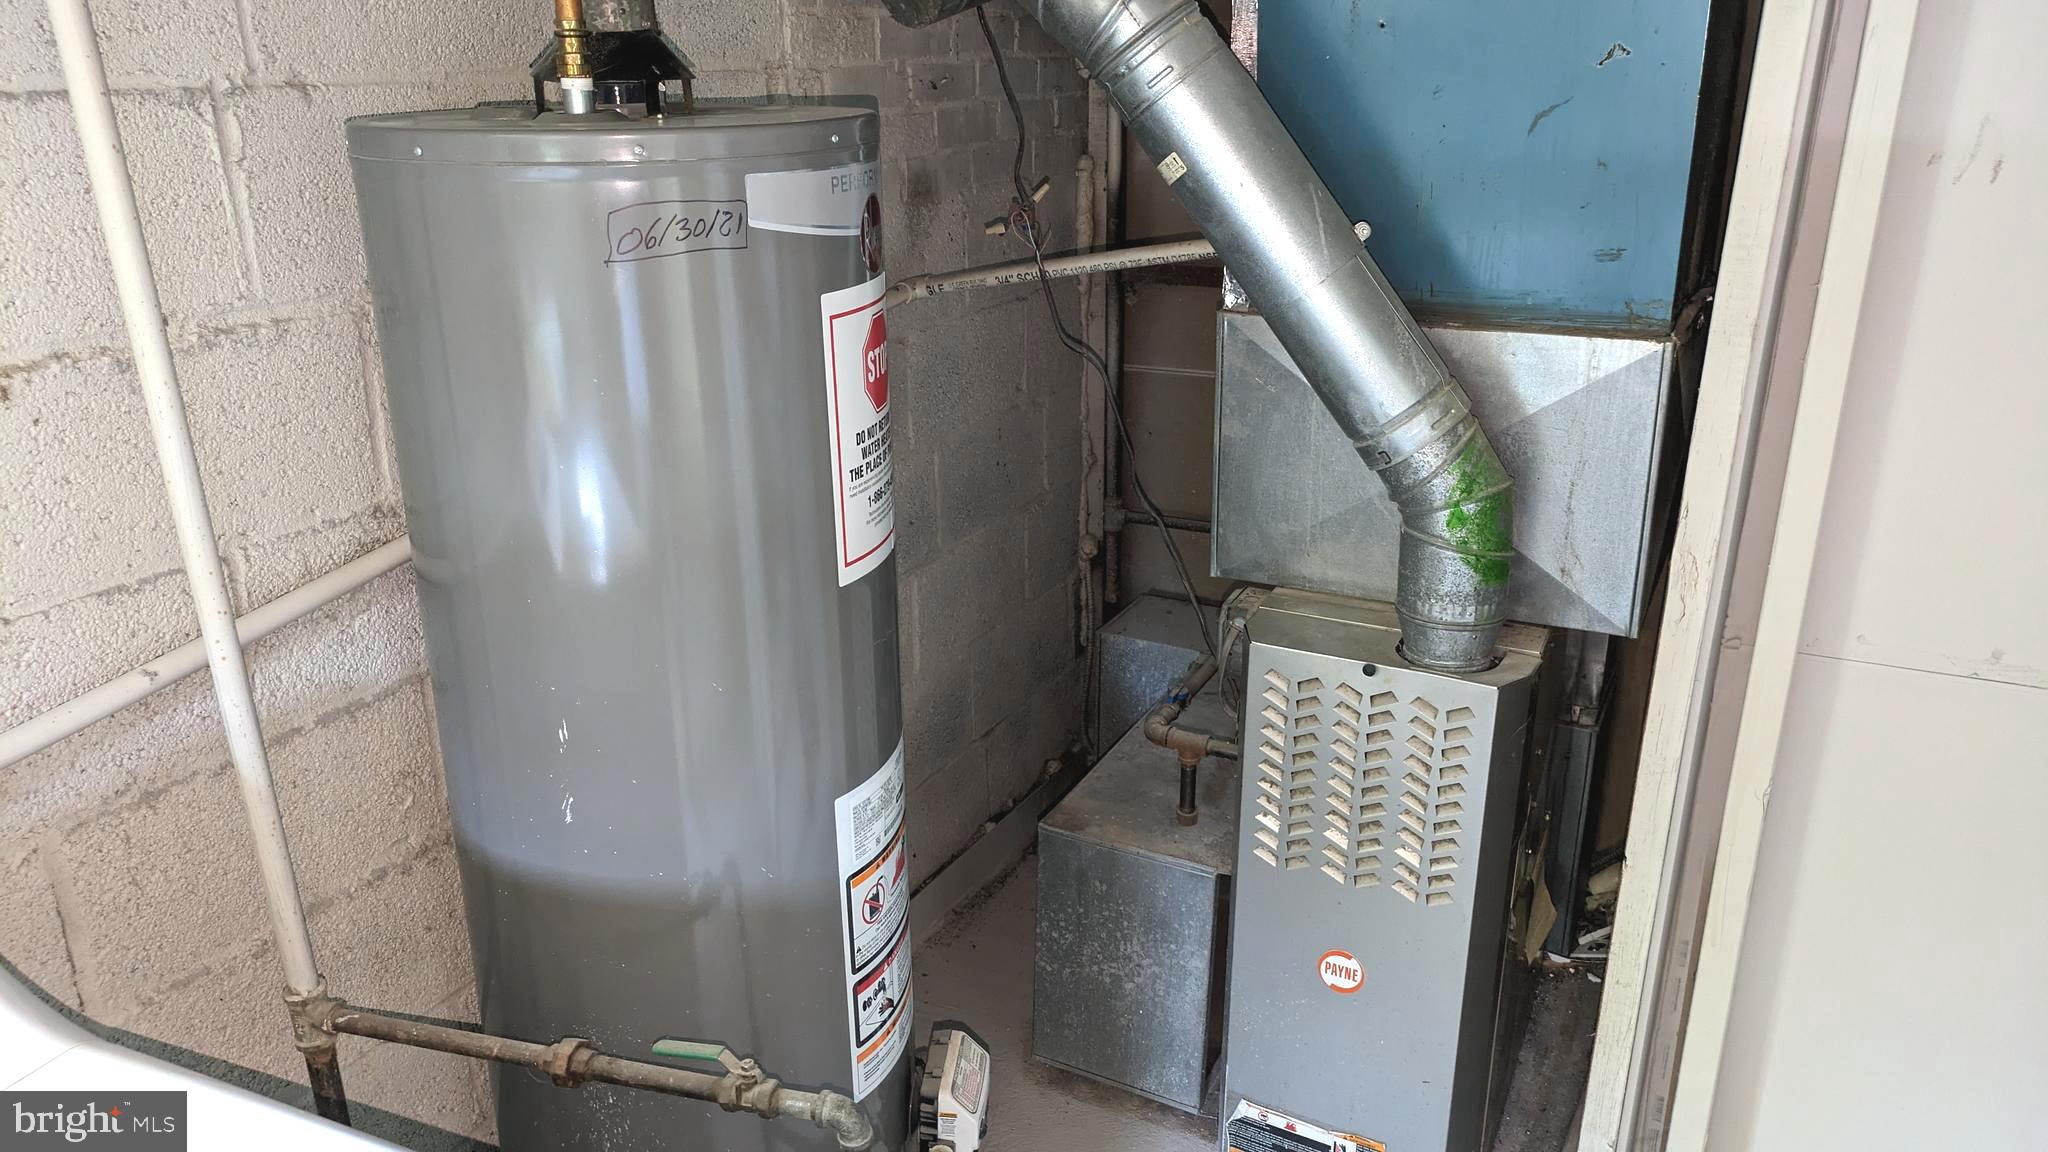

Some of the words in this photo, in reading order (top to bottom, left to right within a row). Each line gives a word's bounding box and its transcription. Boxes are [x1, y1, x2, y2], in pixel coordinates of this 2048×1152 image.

[617, 209, 743, 255] 06/30/21
[856, 429, 866, 446] DO
[867, 422, 878, 440] NOT
[861, 437, 880, 460] WATER
[849, 464, 864, 482] THE
[865, 452, 882, 475] PLACE
[1325, 961, 1359, 983] PAYNE
